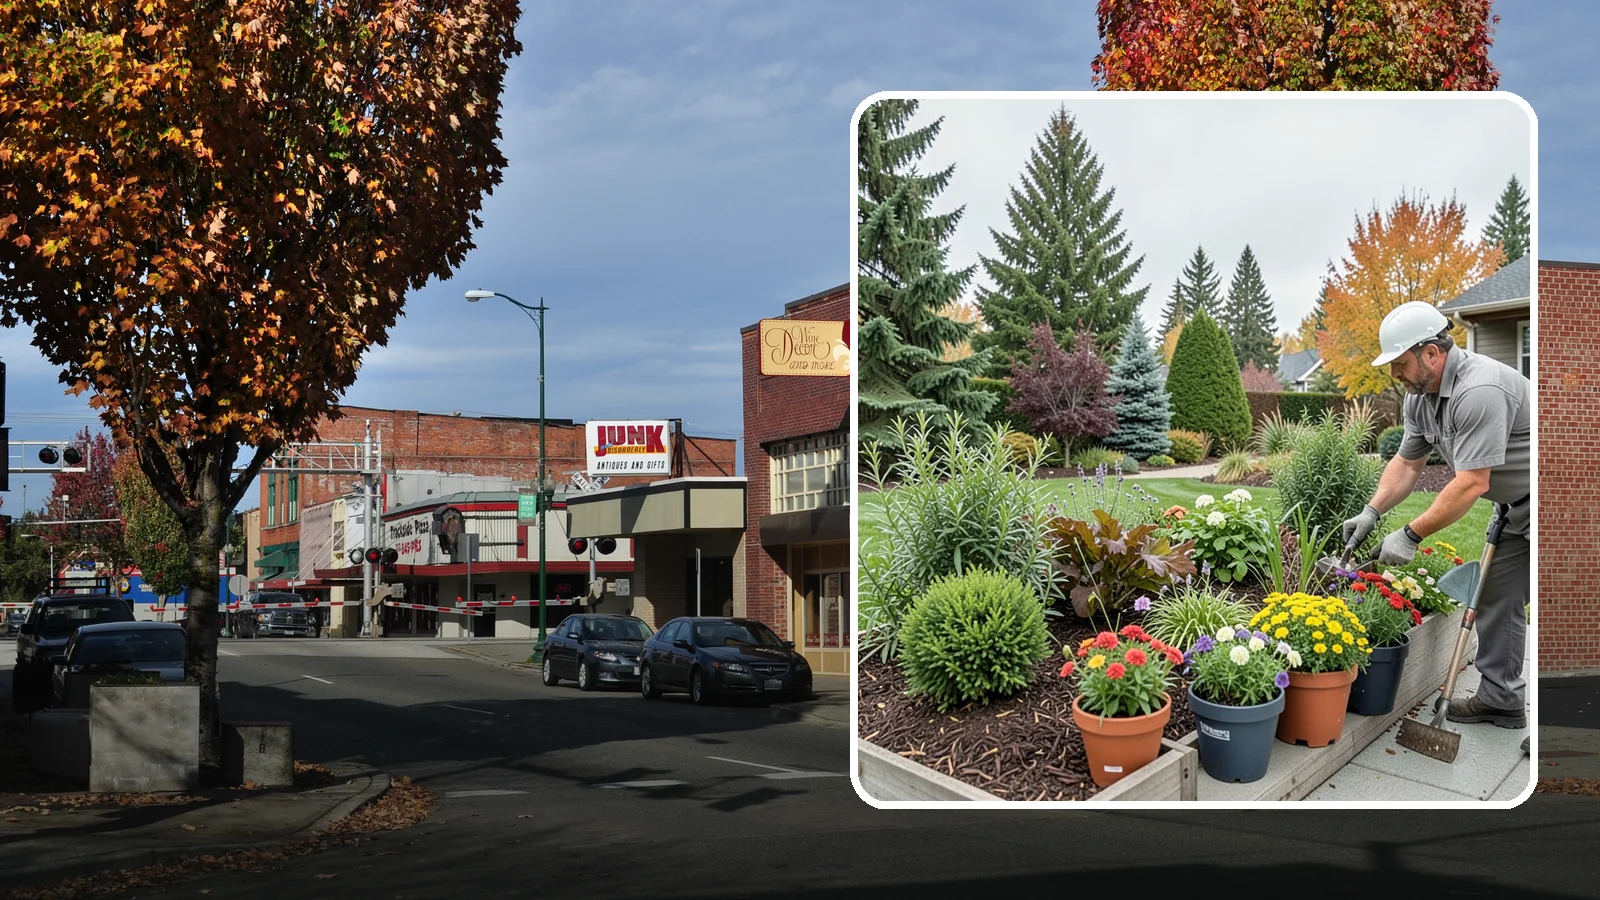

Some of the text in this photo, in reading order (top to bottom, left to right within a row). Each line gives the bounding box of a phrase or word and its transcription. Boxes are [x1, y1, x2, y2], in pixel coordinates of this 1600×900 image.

[596, 425, 666, 457] JUNK
[607, 446, 646, 454] DISORDERLY
[597, 460, 665, 470] ANTIQUES AND GIFTS
[414, 519, 429, 535] Pizza
